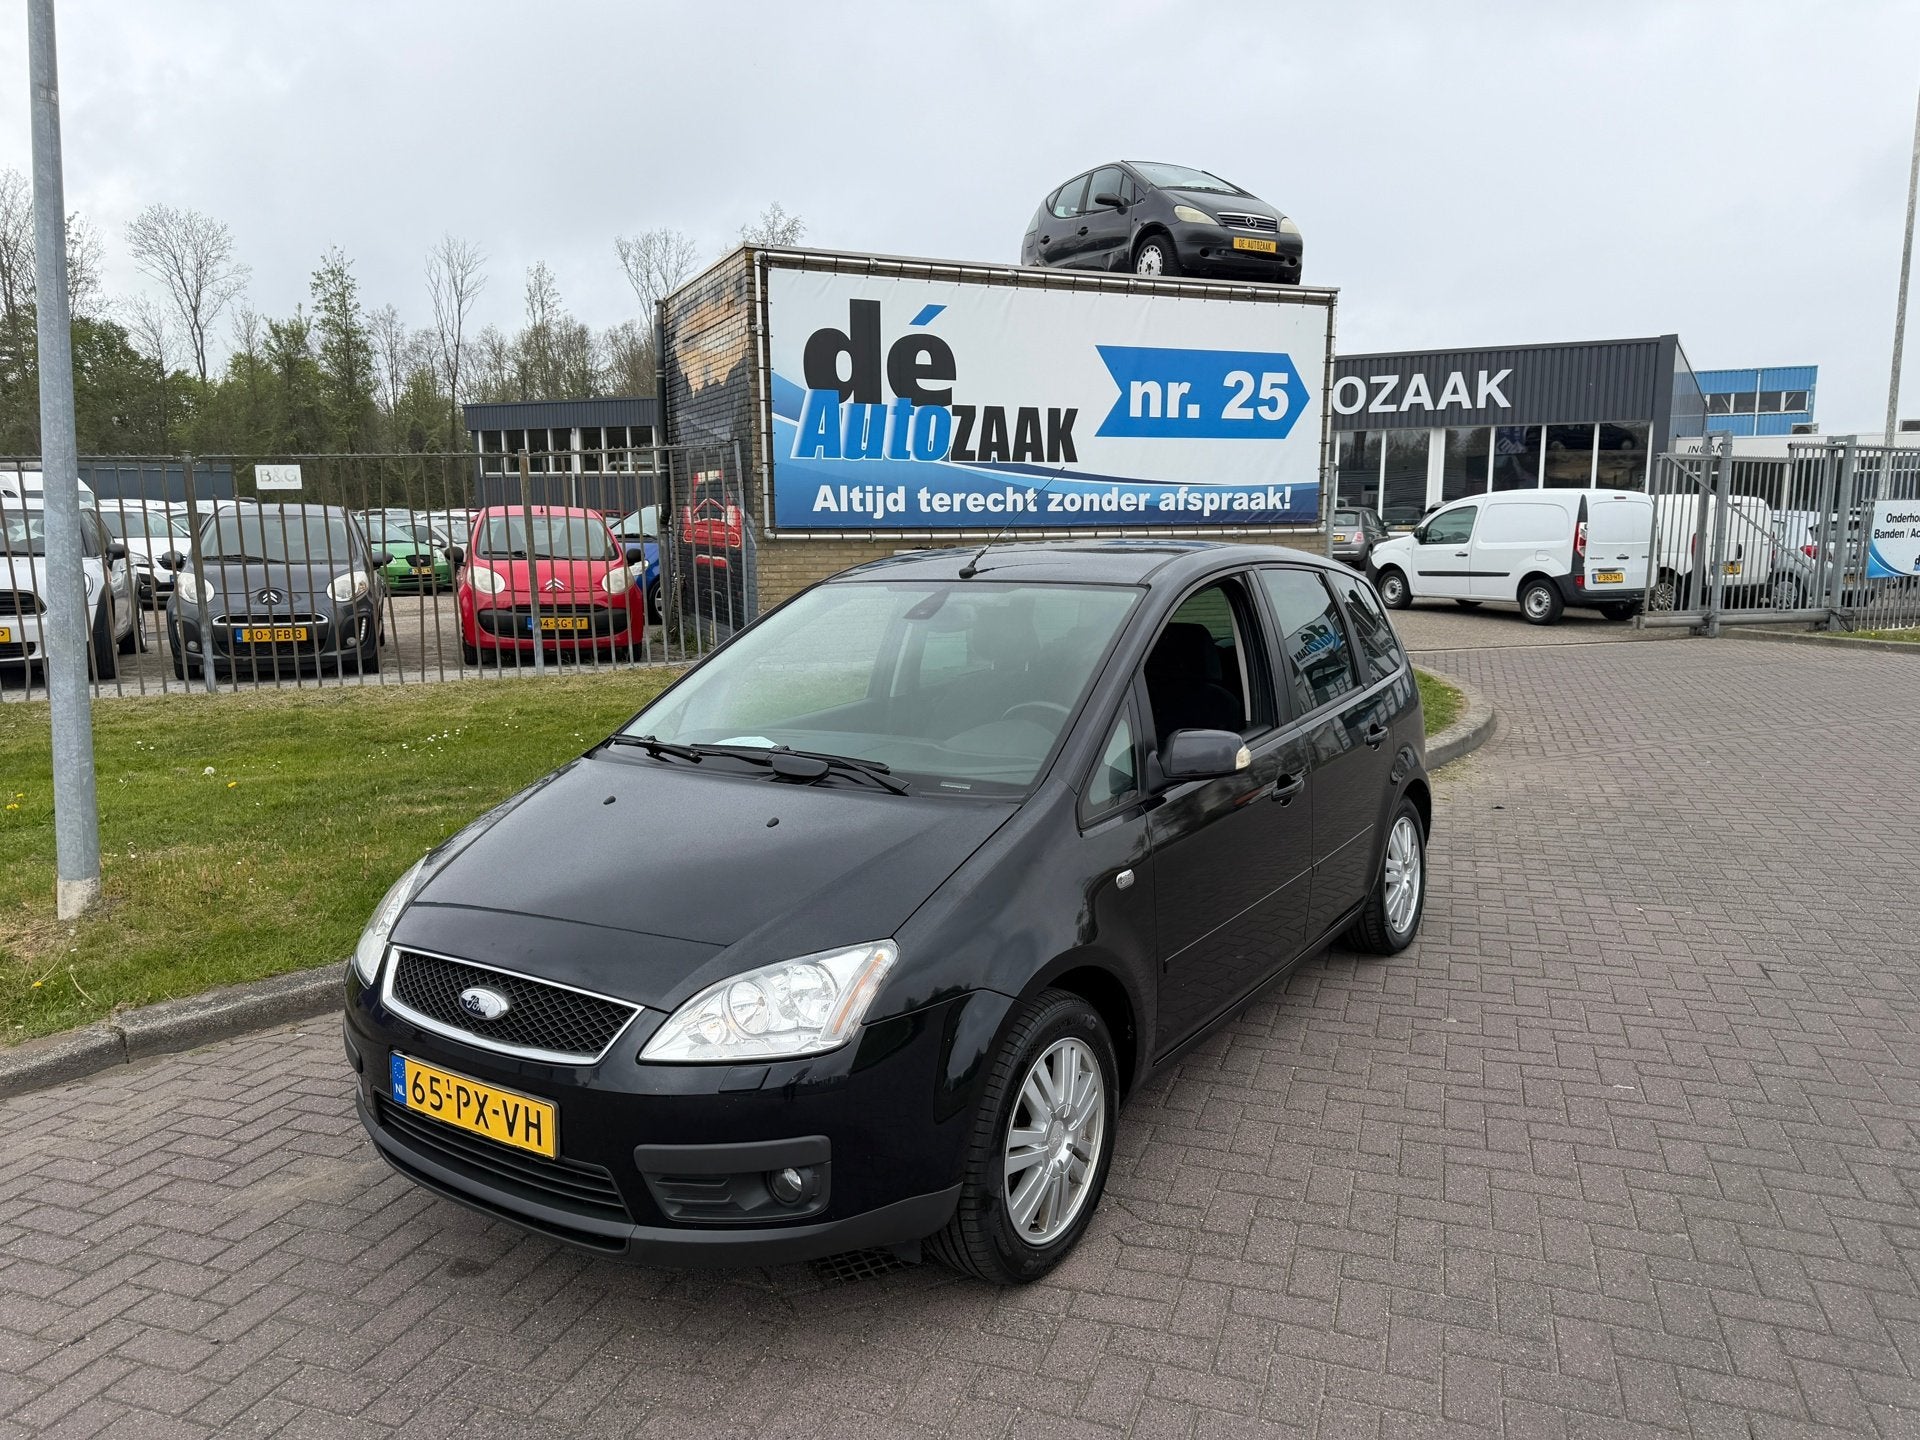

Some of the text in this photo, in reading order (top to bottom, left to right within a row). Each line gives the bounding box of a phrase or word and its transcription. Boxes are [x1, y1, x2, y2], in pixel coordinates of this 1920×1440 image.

[803, 298, 957, 407] dé
[1129, 370, 1290, 421] nr. 25
[1332, 368, 1513, 415] OZAAK
[260, 467, 298, 483] B&G
[812, 485, 1292, 519] Altijd terecht zonder afspraak!
[1886, 512, 1920, 523] Onderho
[1874, 528, 1905, 539] Banden
[395, 1082, 406, 1097] NL
[411, 1071, 542, 1147] 65-PX-VH
